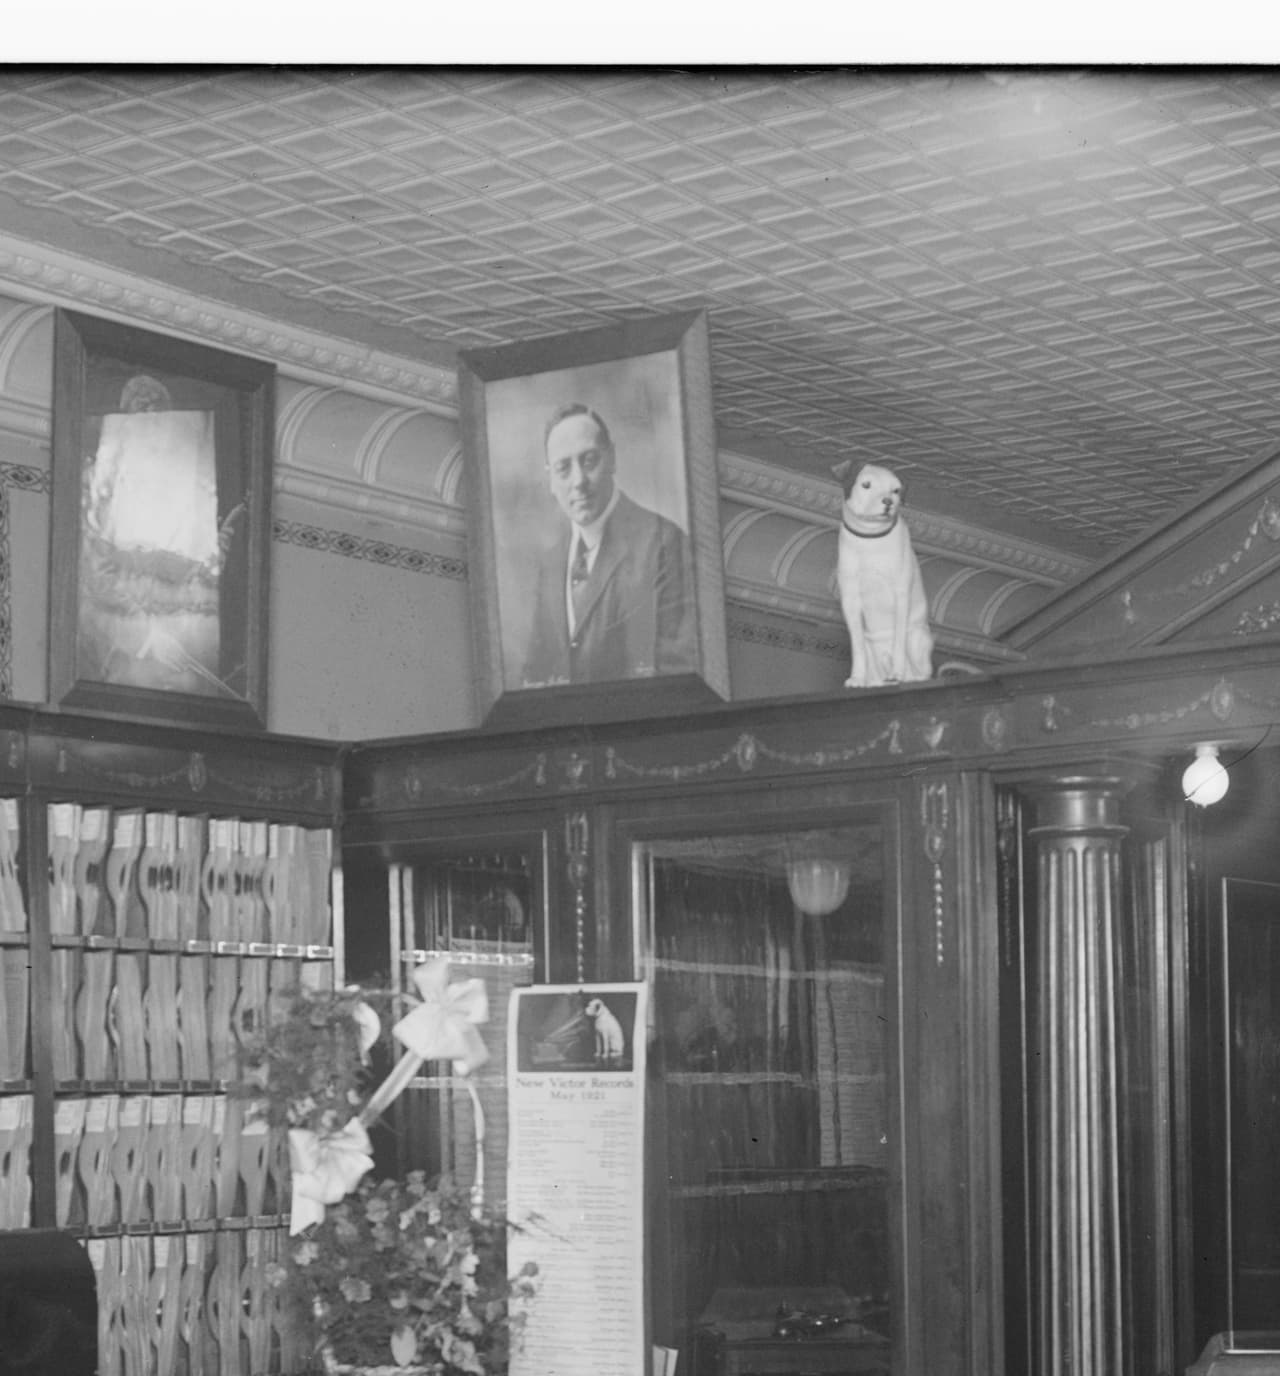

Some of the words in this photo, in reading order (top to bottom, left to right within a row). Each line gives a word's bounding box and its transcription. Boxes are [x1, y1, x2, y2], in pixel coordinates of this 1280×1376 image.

[516, 1077, 544, 1088] New
[549, 1077, 586, 1088] Victor
[591, 1077, 634, 1088] Records
[550, 1090, 574, 1102] May
